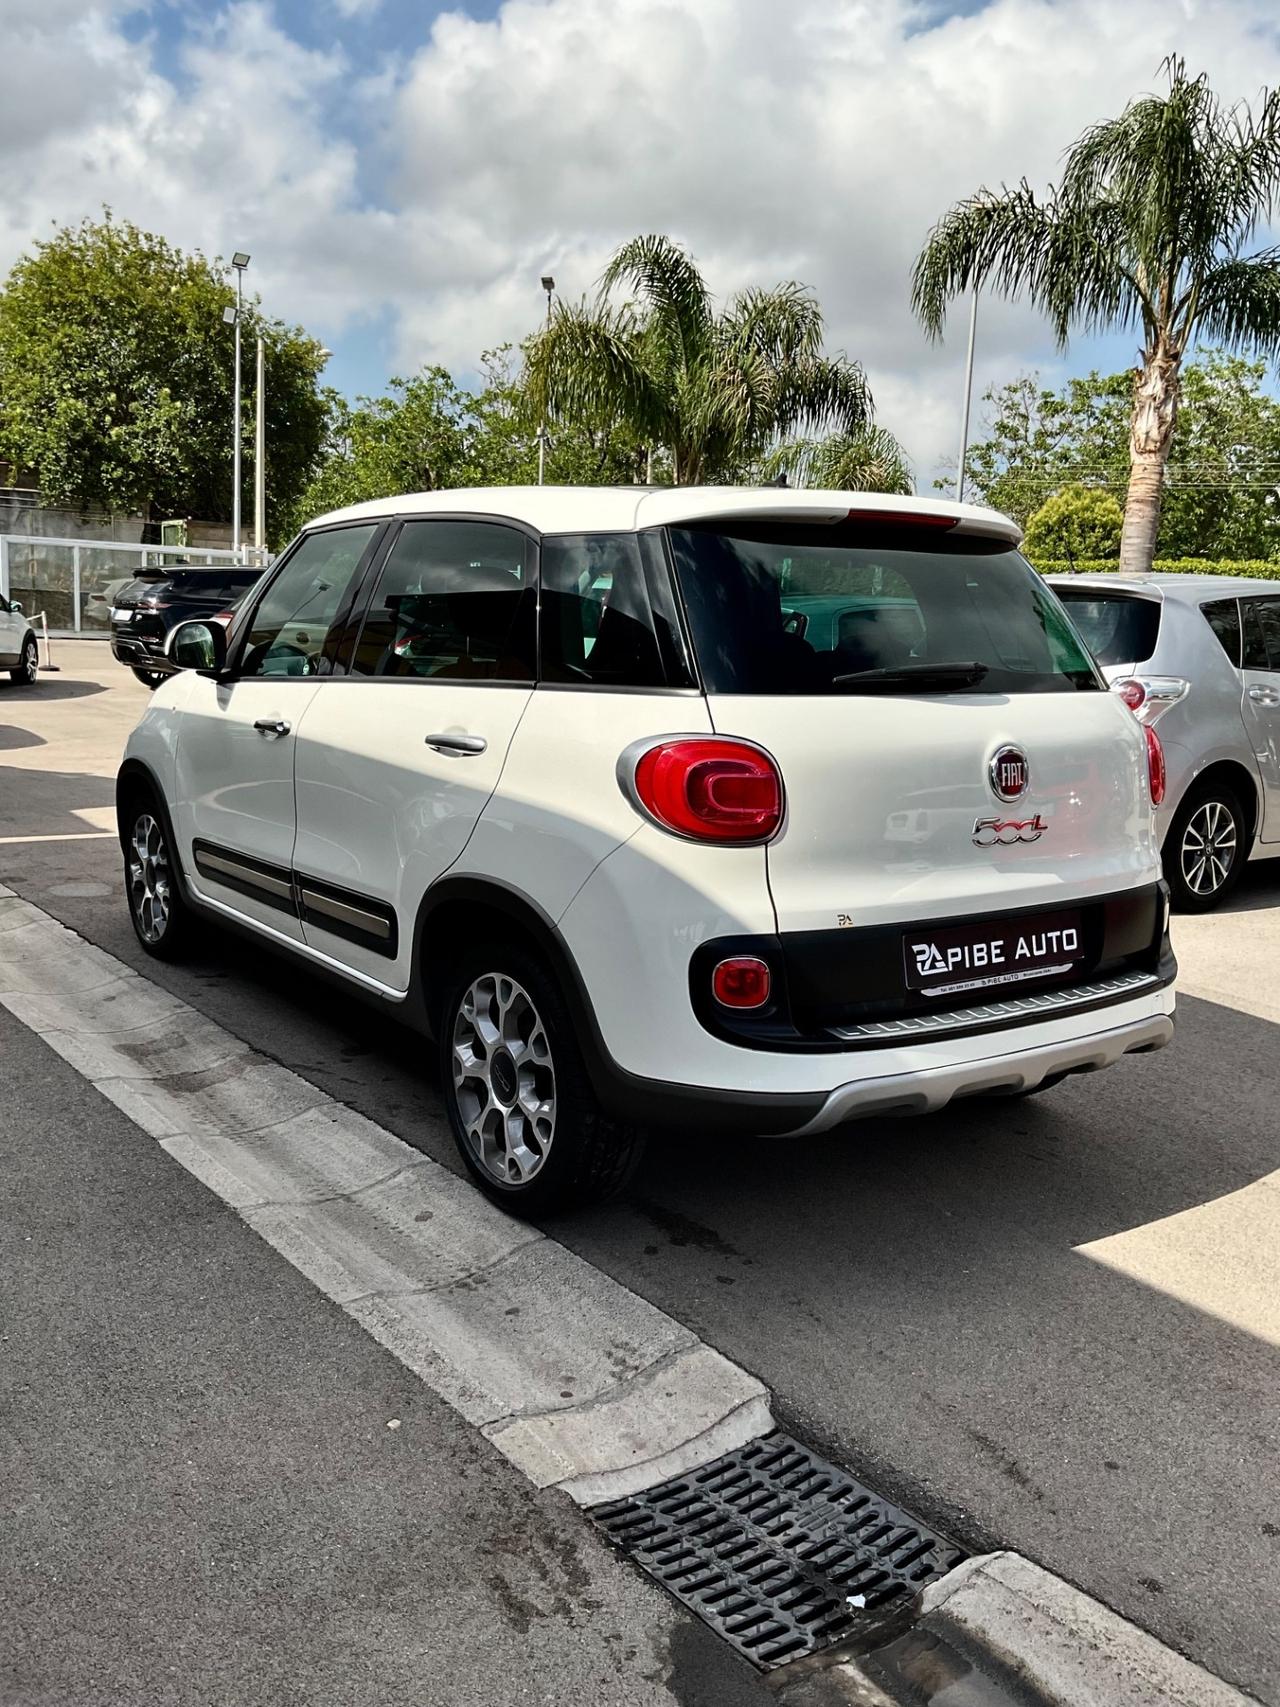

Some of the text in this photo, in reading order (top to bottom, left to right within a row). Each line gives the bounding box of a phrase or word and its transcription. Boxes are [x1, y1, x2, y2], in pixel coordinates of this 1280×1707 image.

[1001, 762, 1024, 787] FIAT
[948, 940, 1005, 971] PIBE
[1015, 928, 1078, 960] AUTO
